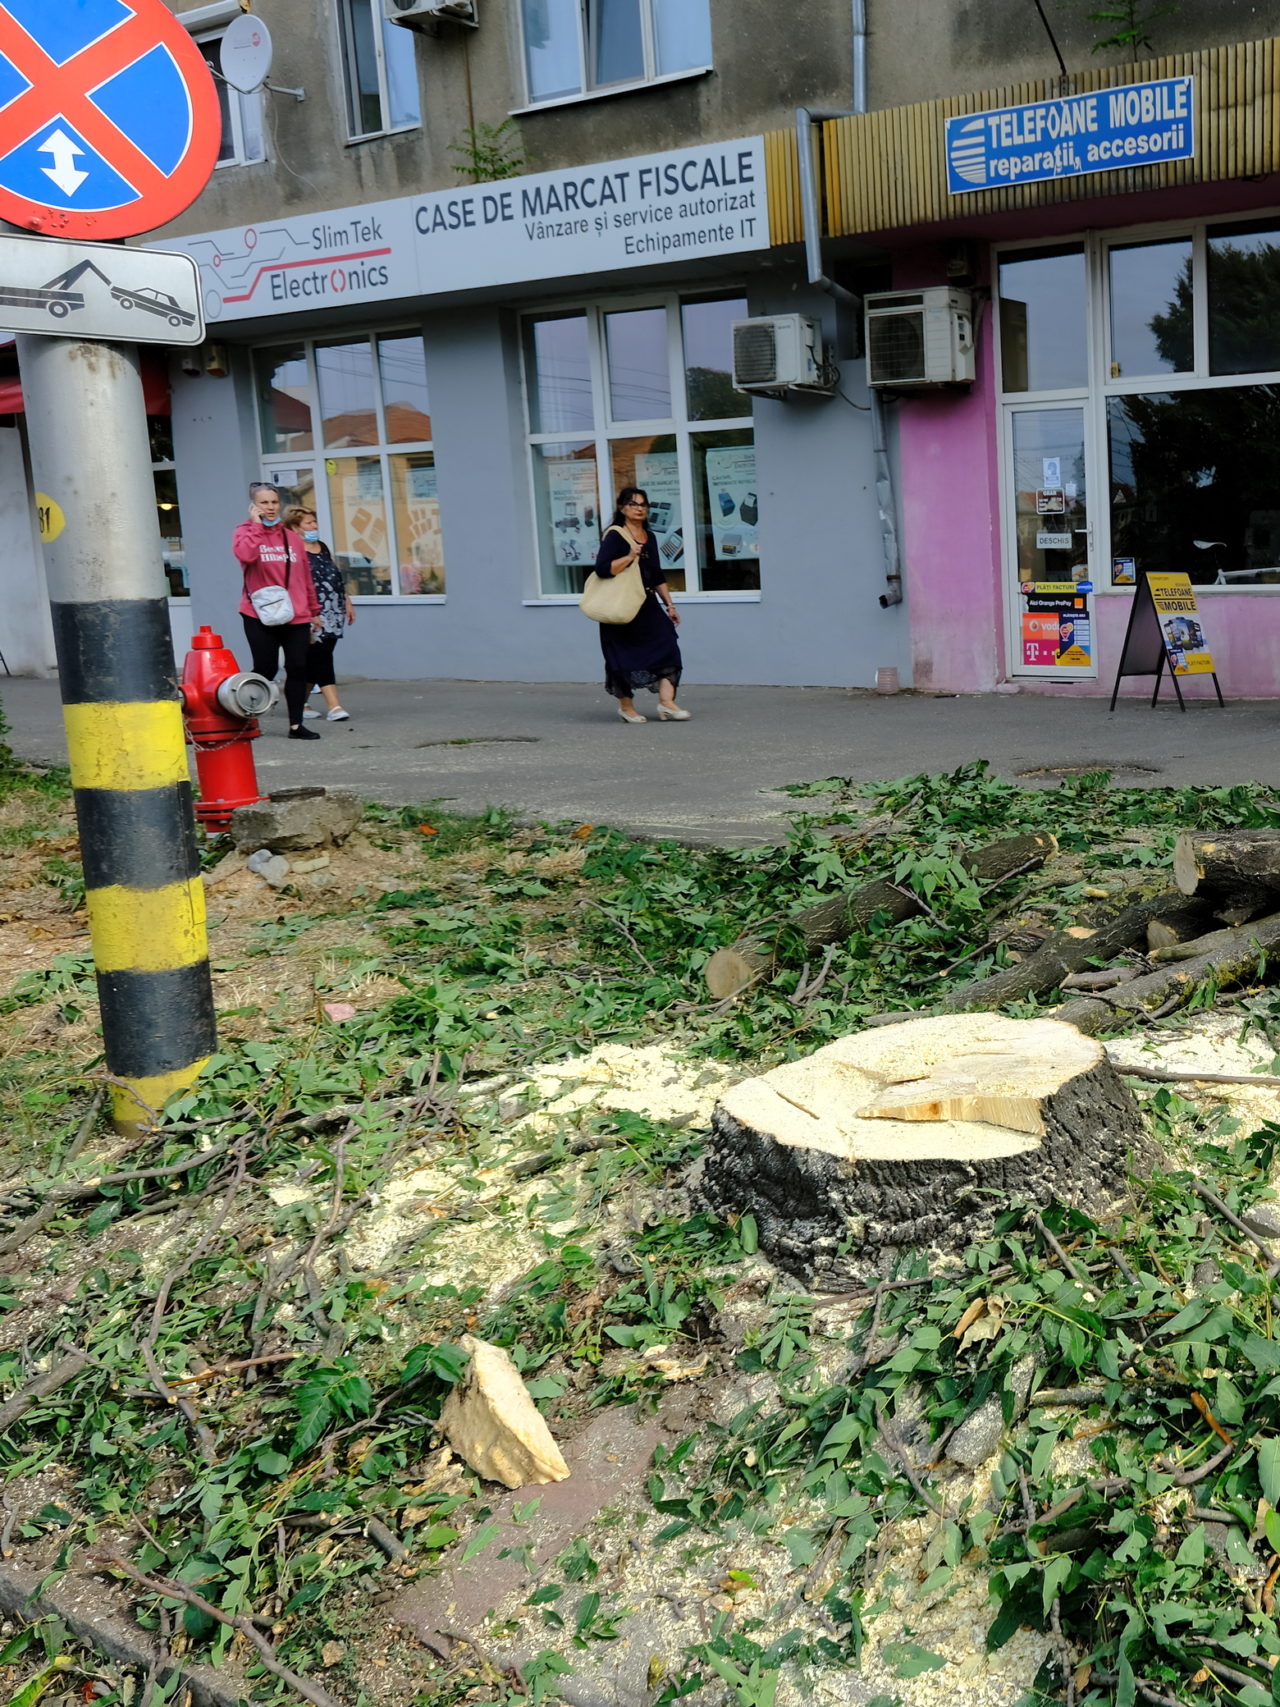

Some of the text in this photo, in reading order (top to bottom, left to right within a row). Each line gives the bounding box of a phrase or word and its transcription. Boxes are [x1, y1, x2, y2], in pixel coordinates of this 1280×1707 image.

[988, 84, 1188, 148] TELEFOANE MOBILE
[1087, 123, 1184, 162] accesorii
[415, 151, 755, 236] CASE DE MARCAT FISCALE
[524, 190, 756, 241] Vânzare și service autorizat
[624, 217, 757, 255] Echipamente IT
[270, 261, 389, 301] Electronics
[1039, 537, 1070, 545] DESCHIS
[1160, 588, 1193, 597] TELEFOANE
[1164, 601, 1197, 611] MOBILE
